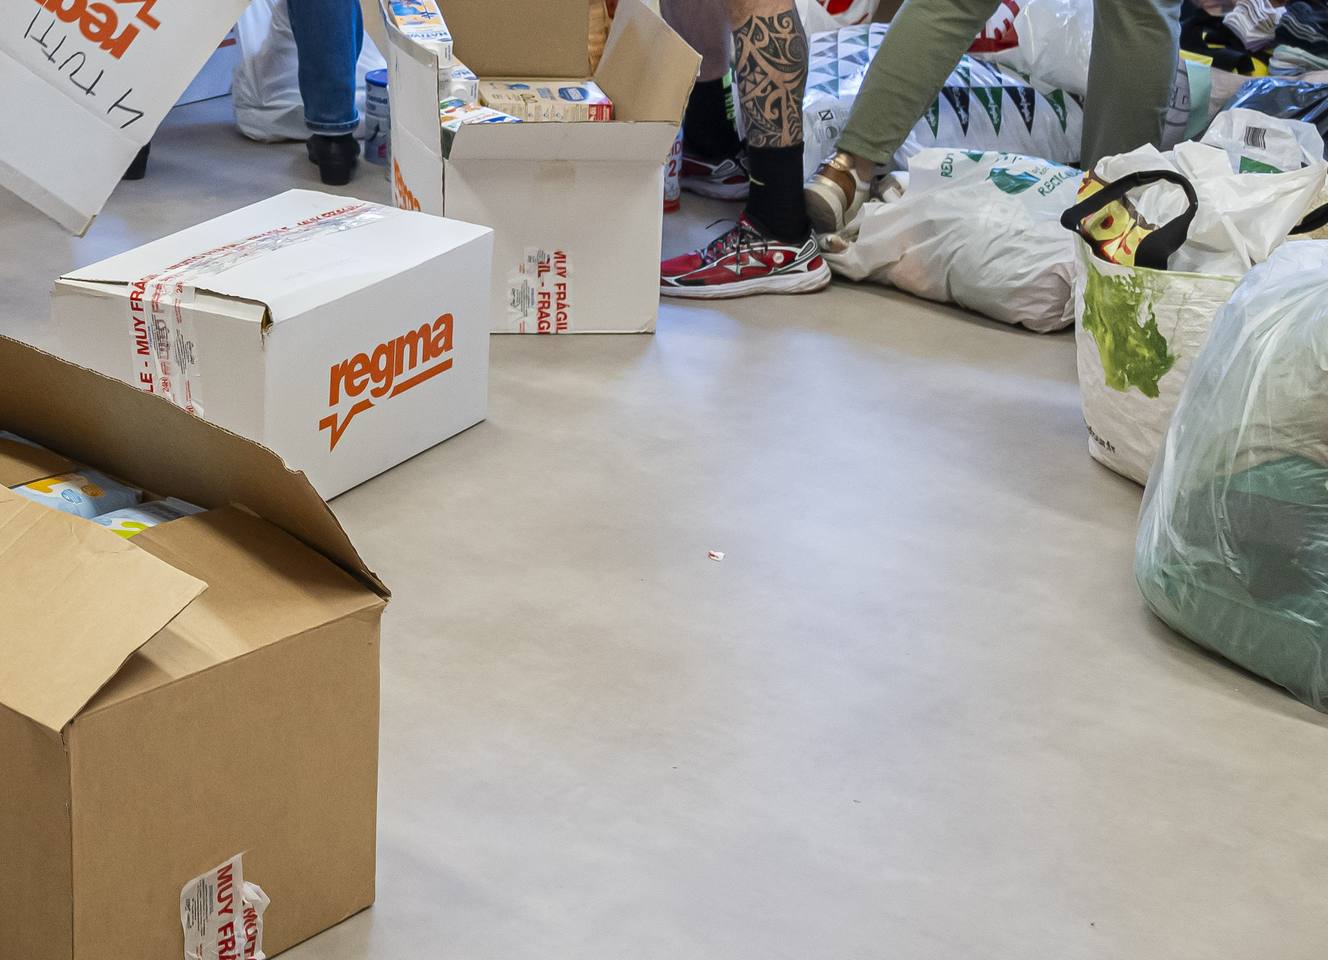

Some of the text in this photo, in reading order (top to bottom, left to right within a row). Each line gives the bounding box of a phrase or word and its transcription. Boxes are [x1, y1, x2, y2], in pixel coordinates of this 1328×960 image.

[132, 316, 151, 356] MUY
[328, 312, 454, 407] regma
[216, 862, 234, 917] MUY
